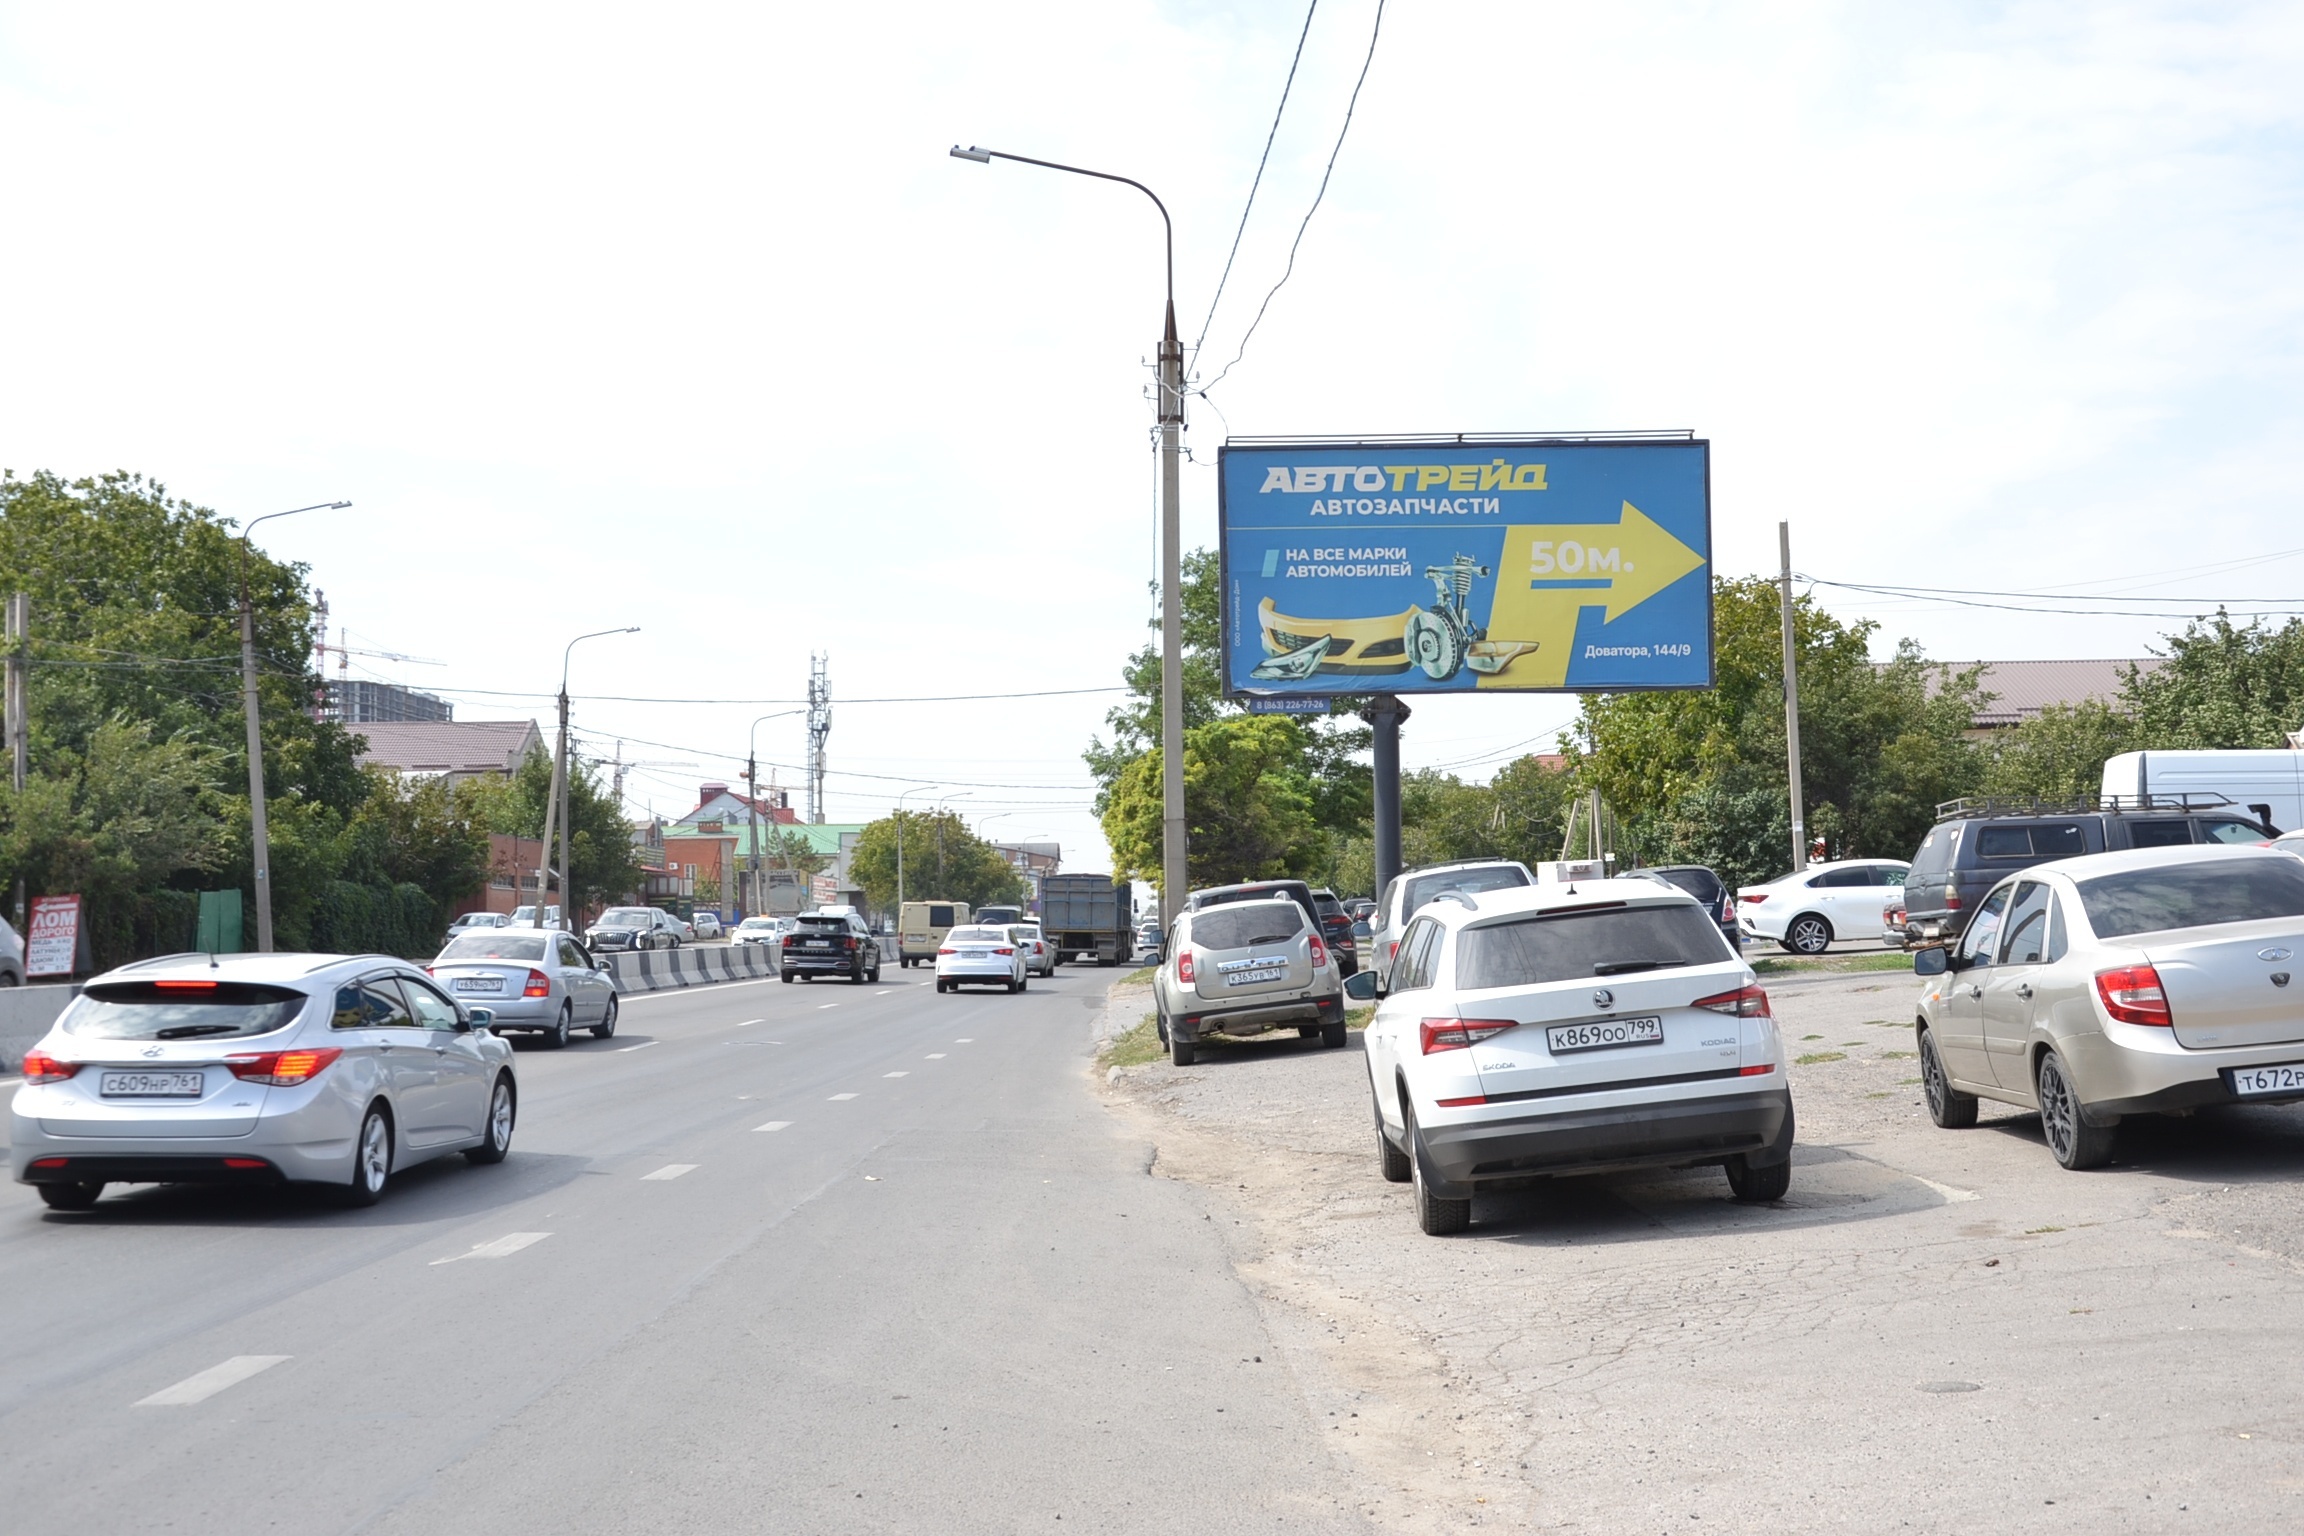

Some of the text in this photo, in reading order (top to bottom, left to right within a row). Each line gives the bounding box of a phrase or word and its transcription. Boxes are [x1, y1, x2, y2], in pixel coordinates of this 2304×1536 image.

[1259, 459, 1548, 493] АВТОТРЕЙД
[1310, 498, 1500, 516] АВТОЗАПЧАСТИ
[1286, 547, 1407, 562] НА ВСЕ МАРКИ
[1285, 561, 1412, 578] АВТОМОБИЛЕЙ
[1584, 643, 1692, 659] Доватора, 144/9
[1256, 700, 1324, 710] 8 (863) 226-77-26
[32, 910, 78, 929] ЛОМ
[31, 927, 75, 940] ДОРОГО
[1221, 959, 1286, 972] DUSTER
[1700, 1037, 1737, 1047] KODIAQ
